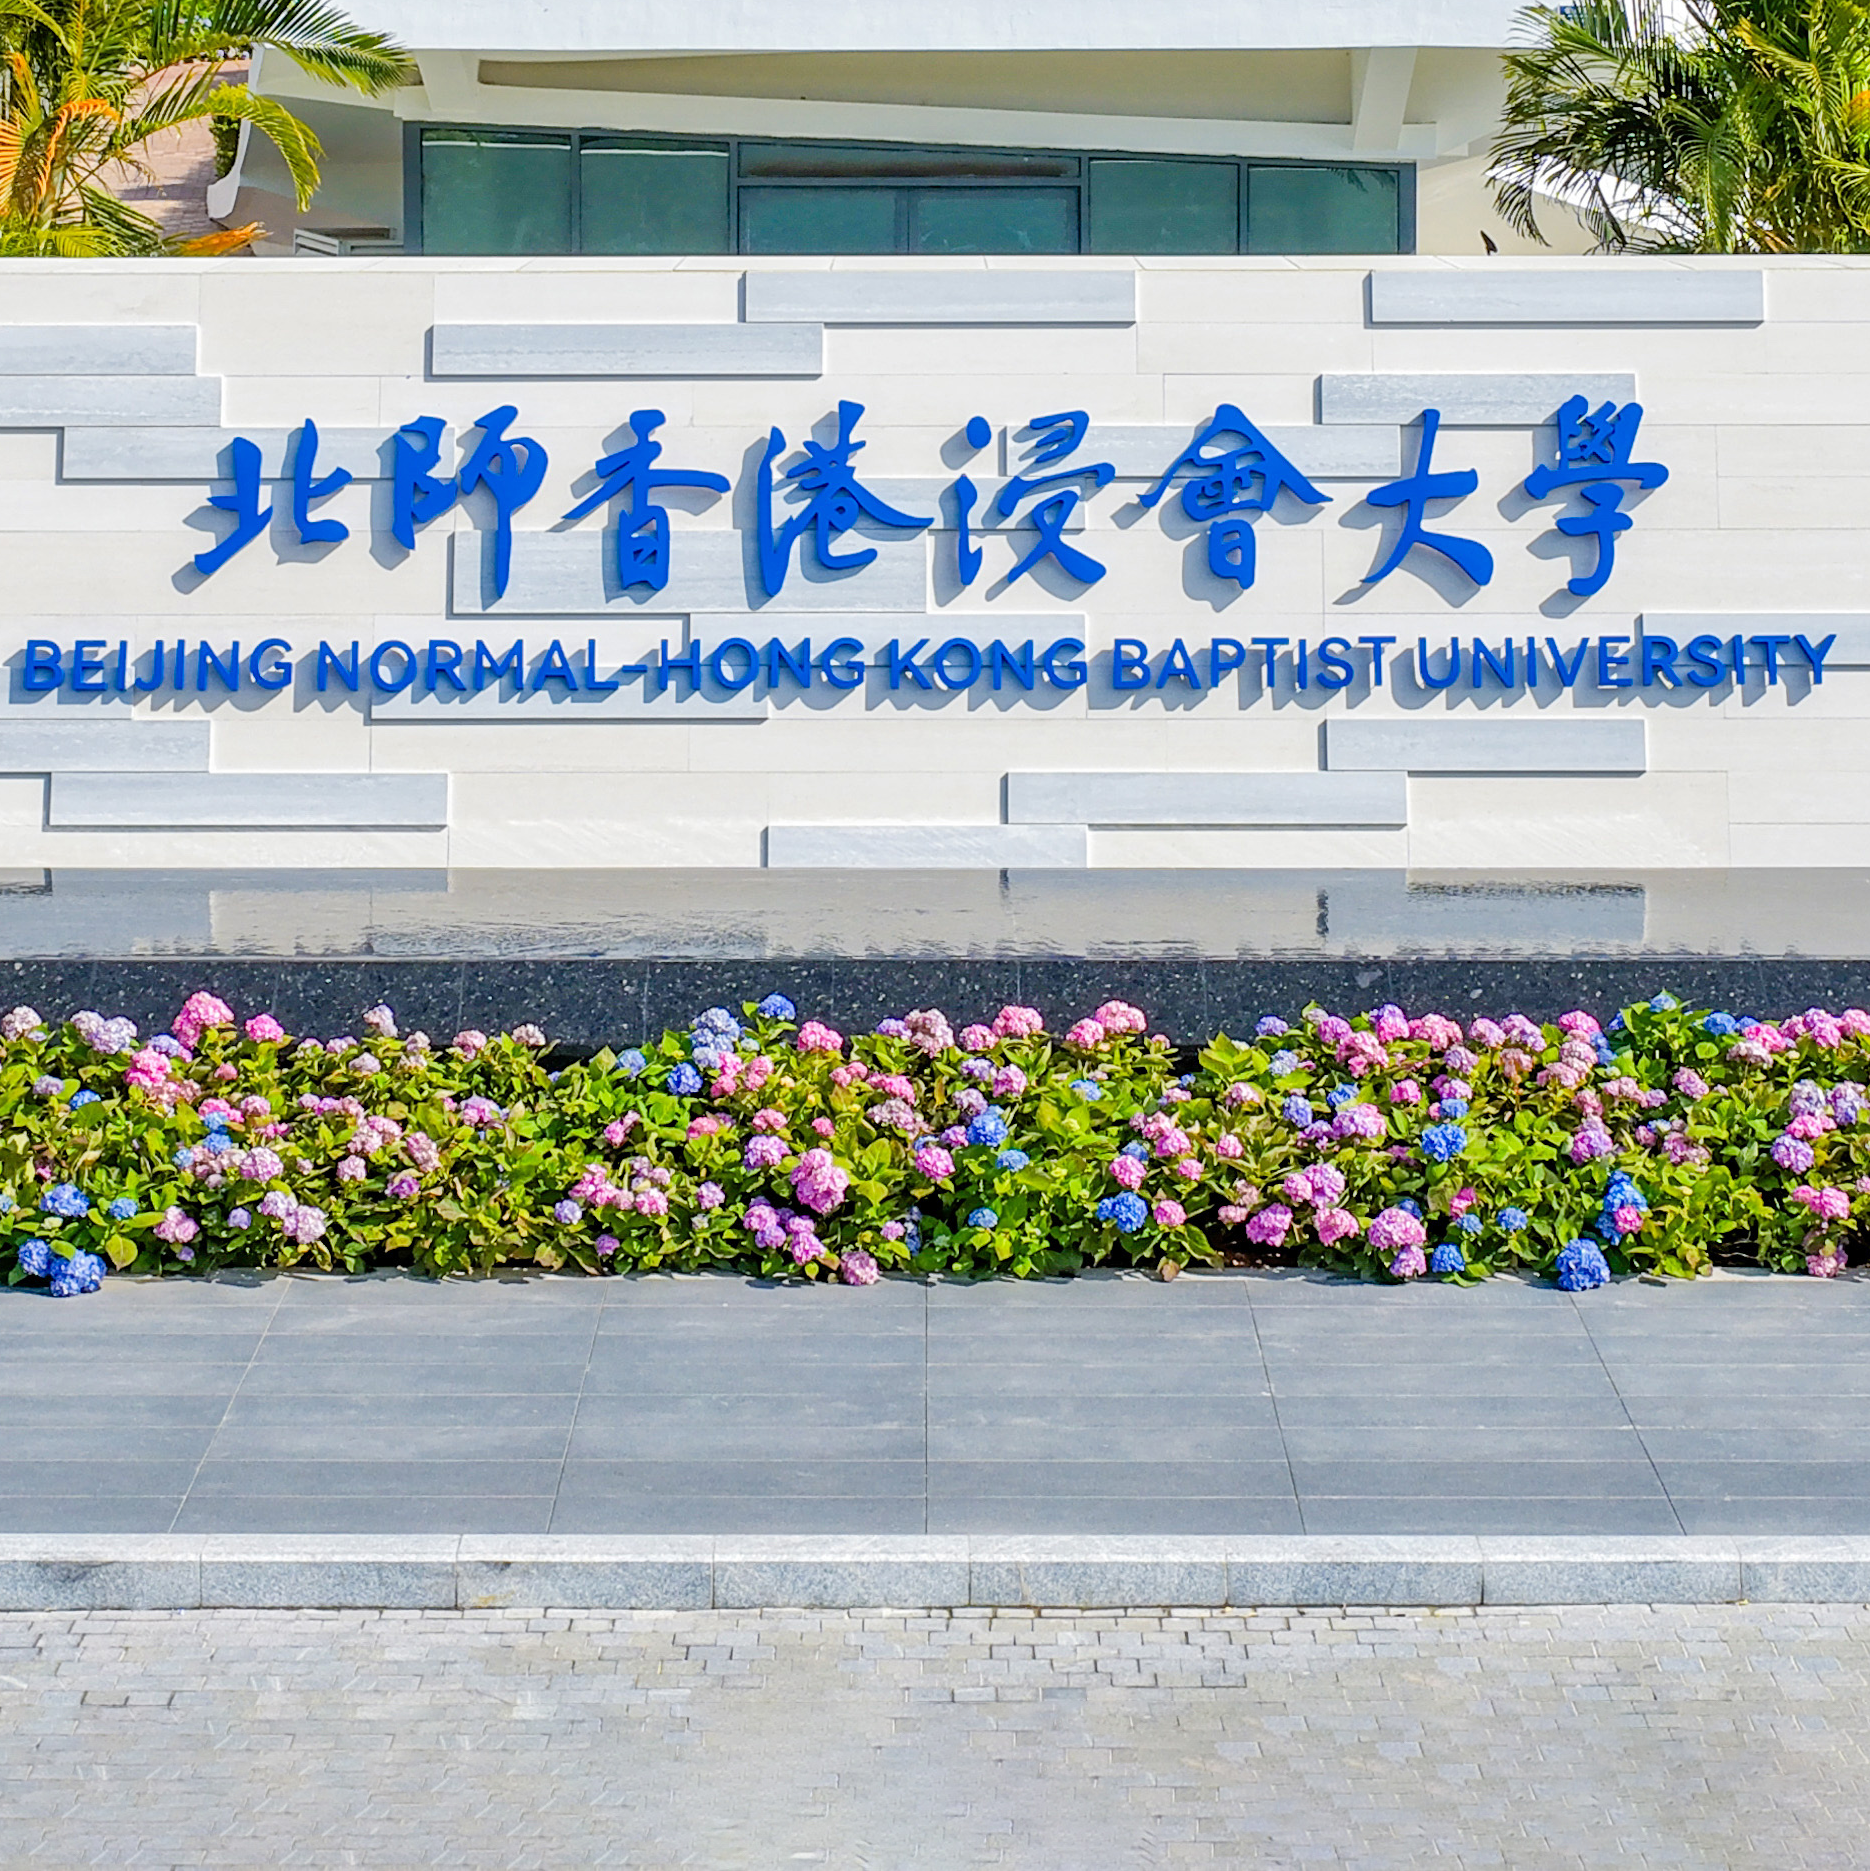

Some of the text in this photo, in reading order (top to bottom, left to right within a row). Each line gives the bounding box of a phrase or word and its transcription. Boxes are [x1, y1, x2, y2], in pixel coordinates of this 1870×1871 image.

[194, 393, 1669, 598] 北師香港浸會大學
[23, 633, 1837, 693] BEIJING NORMAL-HONG KONG BAPTIST UNIVERSITY
